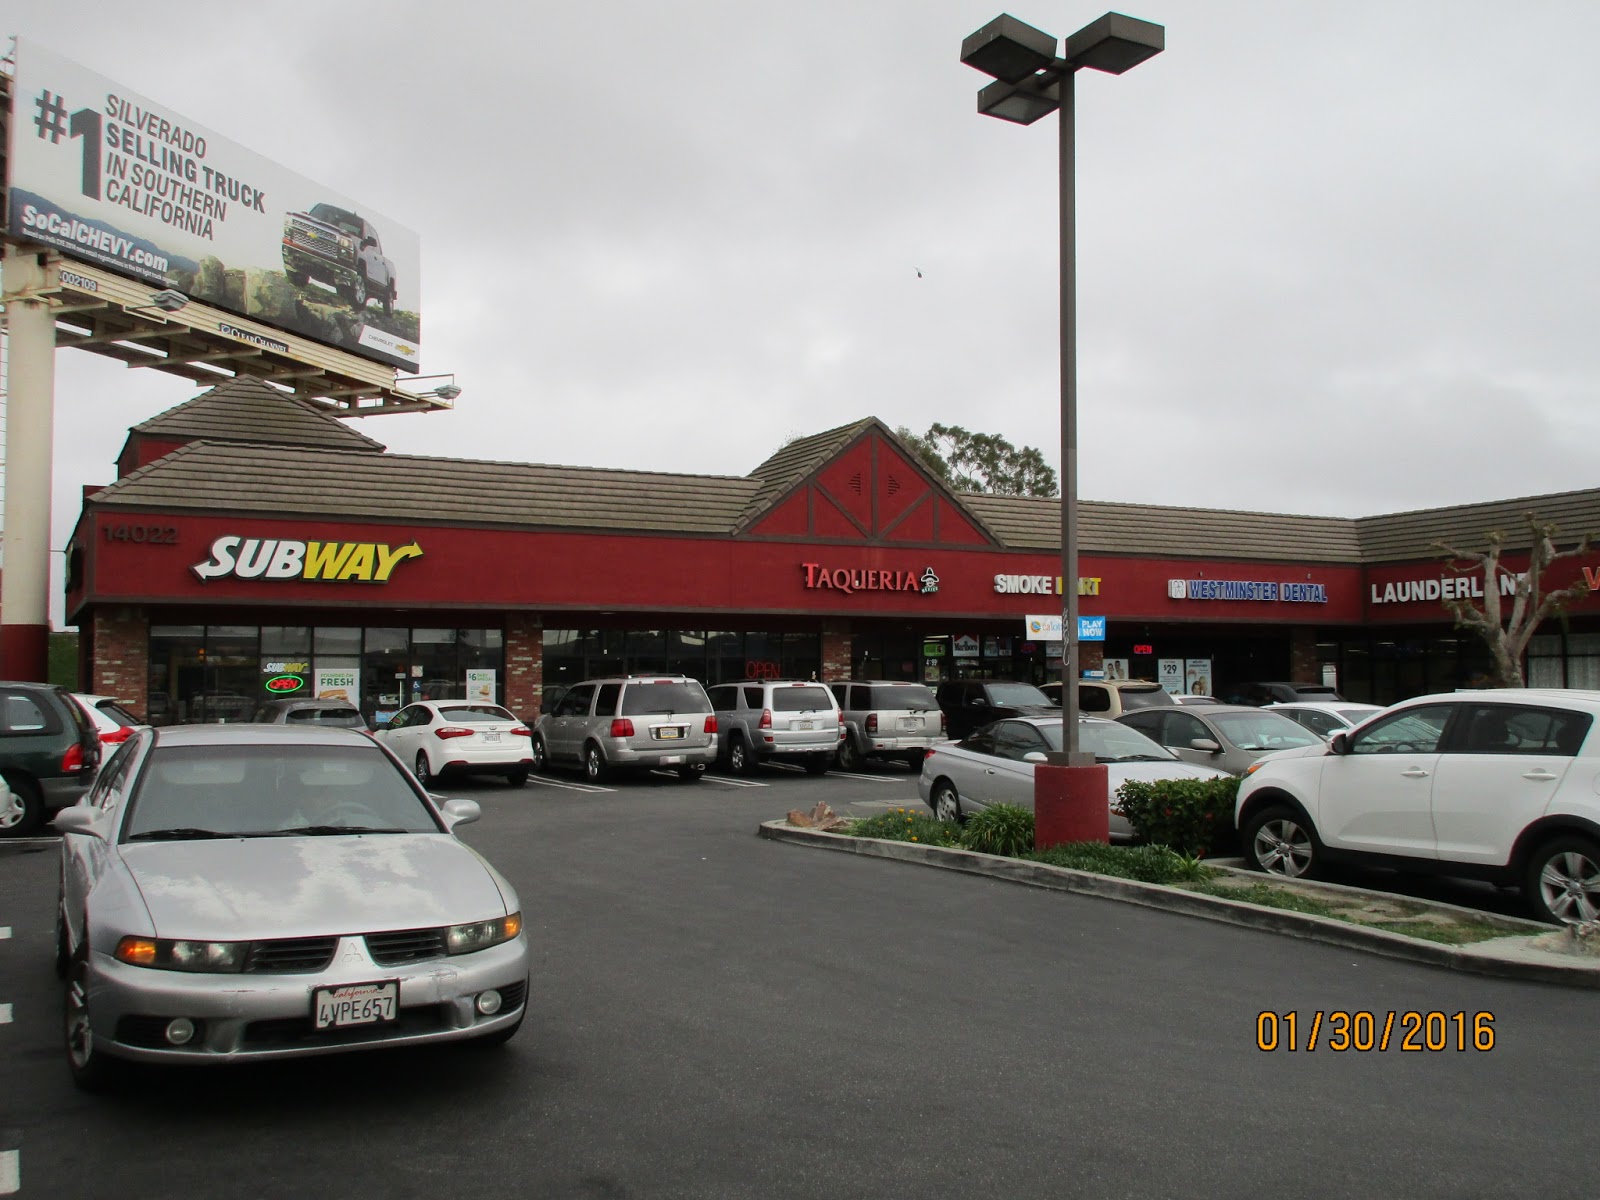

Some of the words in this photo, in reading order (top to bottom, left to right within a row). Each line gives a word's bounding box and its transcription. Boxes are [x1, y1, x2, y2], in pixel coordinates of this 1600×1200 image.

[106, 94, 207, 158] SILVERADO
[34, 89, 101, 200] #1
[106, 123, 197, 184] SELLING
[202, 165, 266, 214] TRUCK
[106, 152, 127, 180] IN
[131, 163, 227, 222] SOUTHERN
[106, 179, 213, 241] CALIFORNIA
[22, 204, 169, 273] SoCalCHEVY.com
[368, 334, 394, 346] CHEVROLET
[102, 525, 178, 544] 14022
[193, 536, 424, 582] SUBWAY
[802, 563, 919, 594] TAQUERIA
[994, 574, 1052, 594] SMOKE
[1056, 576, 1101, 595] RT
[1371, 572, 1532, 603] LAUNDERLN
[1188, 580, 1278, 600] WESTMINSTER
[1282, 583, 1328, 602] DENTAL
[1082, 620, 1102, 628] PLAY
[1083, 628, 1103, 636] NOW
[954, 642, 978, 651] Marlboro
[1134, 645, 1152, 654] OPEN
[263, 662, 309, 673] SUBWAY
[746, 660, 781, 679] OPEN
[1163, 664, 1177, 674] $29
[269, 679, 298, 689] OPEN
[320, 678, 354, 686] FRESH
[333, 987, 383, 999] California
[319, 997, 393, 1022] 4VPE657
